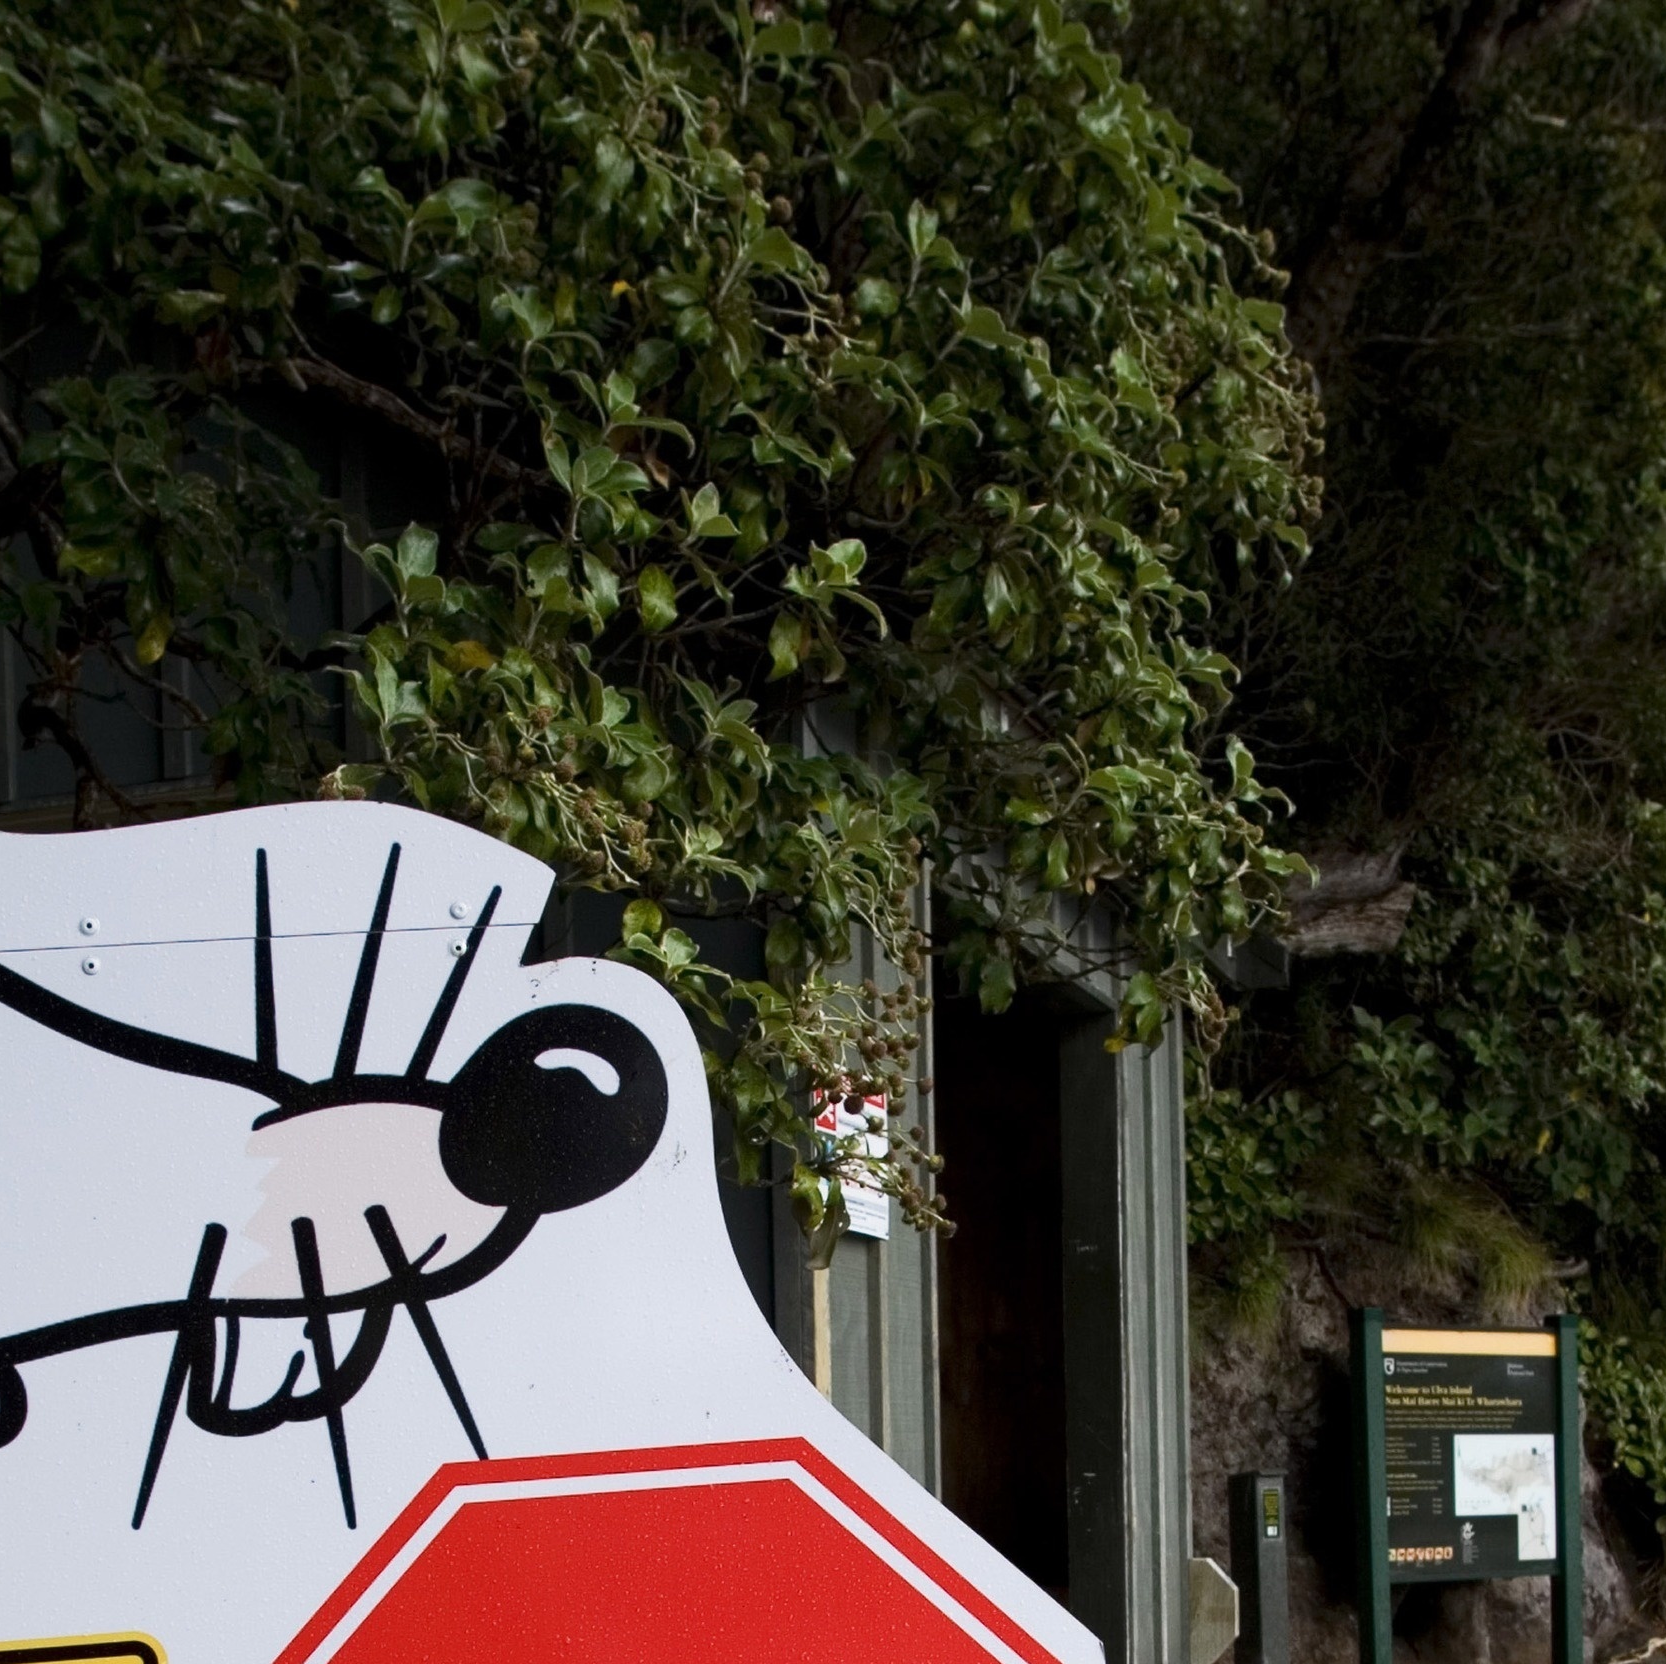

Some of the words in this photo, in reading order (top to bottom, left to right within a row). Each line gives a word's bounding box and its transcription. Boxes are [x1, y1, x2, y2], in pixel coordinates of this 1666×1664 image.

[1385, 1385, 1419, 1395] Welcome
[1421, 1386, 1431, 1395] to
[1449, 1385, 1473, 1395] Island
[1402, 1396, 1417, 1406] Mai
[1442, 1397, 1456, 1406] Mai
